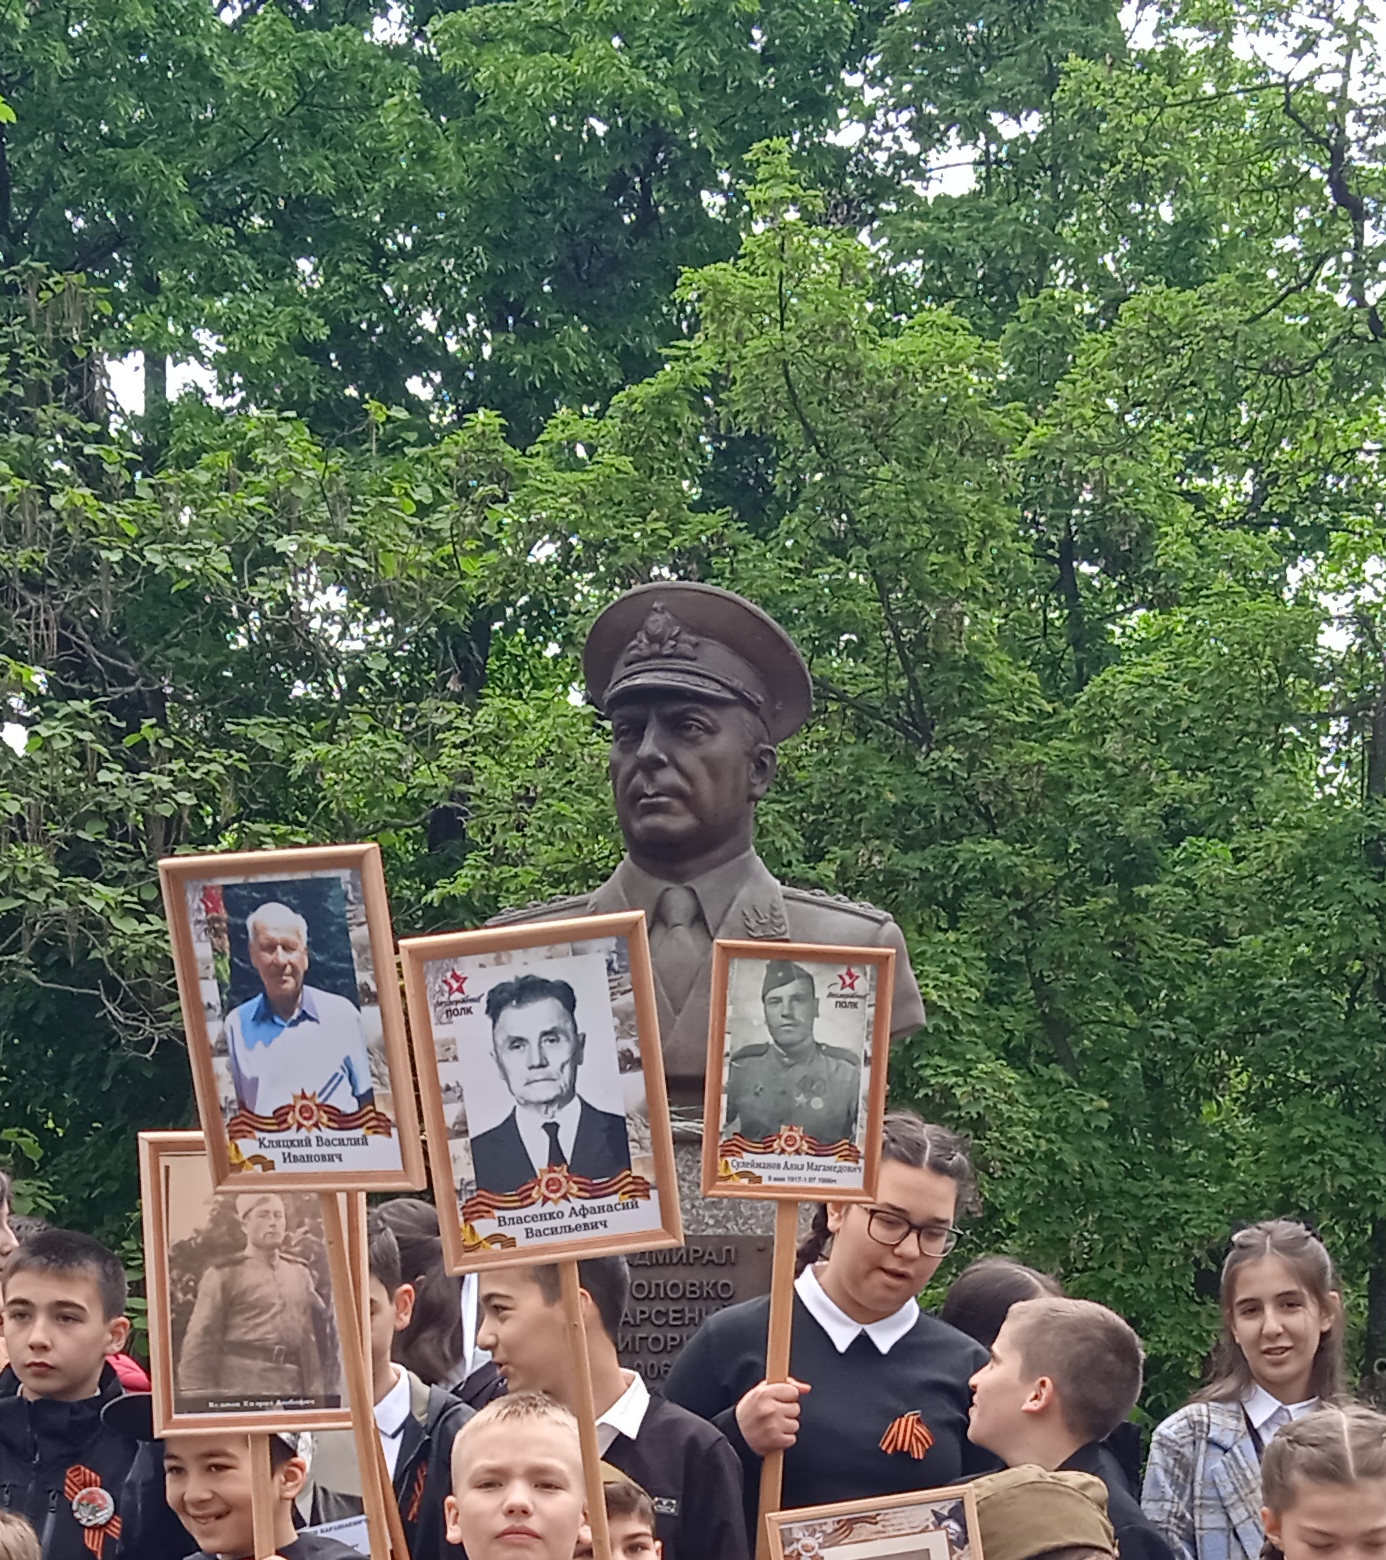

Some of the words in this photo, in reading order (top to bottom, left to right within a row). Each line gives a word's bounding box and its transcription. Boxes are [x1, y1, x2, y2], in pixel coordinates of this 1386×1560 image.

[835, 1000, 859, 1009] ПОЛК
[445, 1006, 474, 1019] ПОЛК
[258, 1136, 313, 1149] Кляцкий
[315, 1134, 369, 1148] Василий
[281, 1152, 343, 1164] Иванович
[497, 1209, 564, 1228] Власенко
[568, 1199, 640, 1219] Афанасий
[524, 1219, 609, 1239] Васильевич
[631, 1279, 734, 1300] ОЛОВКО
